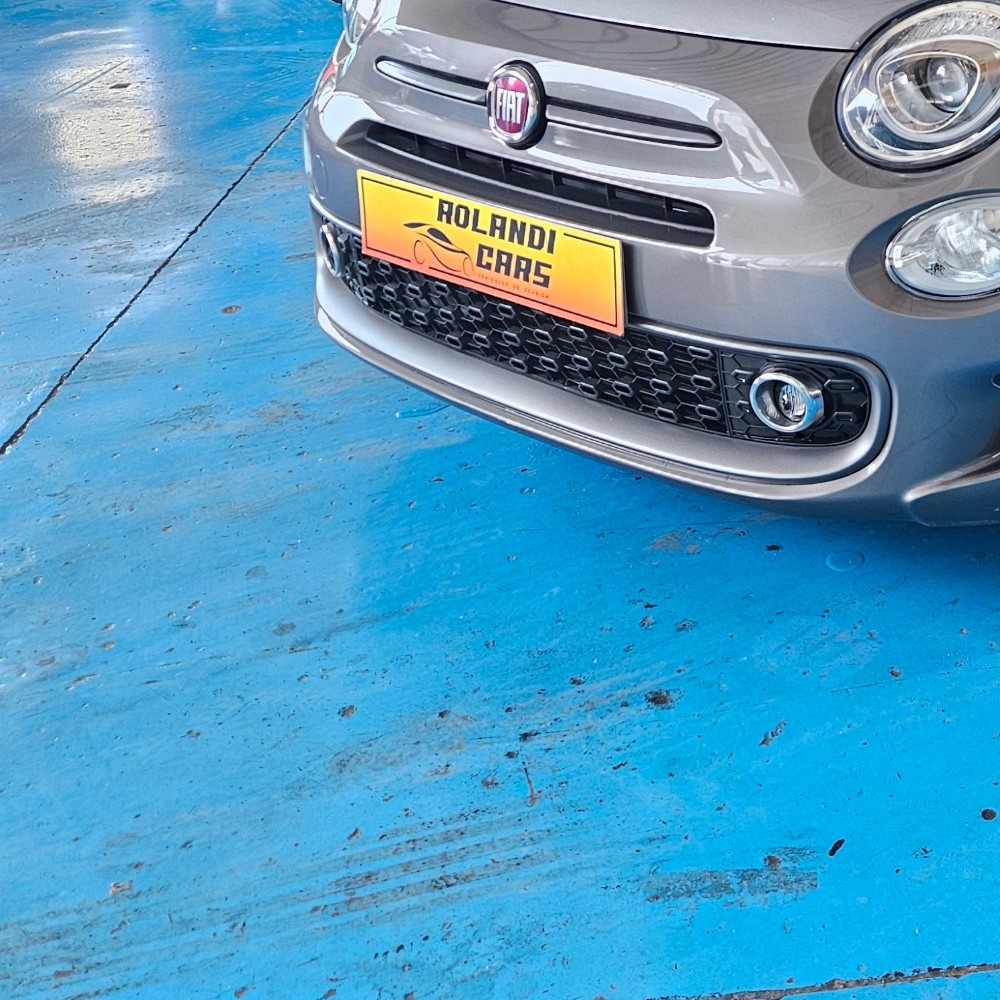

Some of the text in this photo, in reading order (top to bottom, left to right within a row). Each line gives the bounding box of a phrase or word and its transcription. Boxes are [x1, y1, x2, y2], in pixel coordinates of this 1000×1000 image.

[497, 88, 526, 124] FIAT
[437, 198, 556, 254] ROLANDI
[476, 243, 552, 288] CARS
